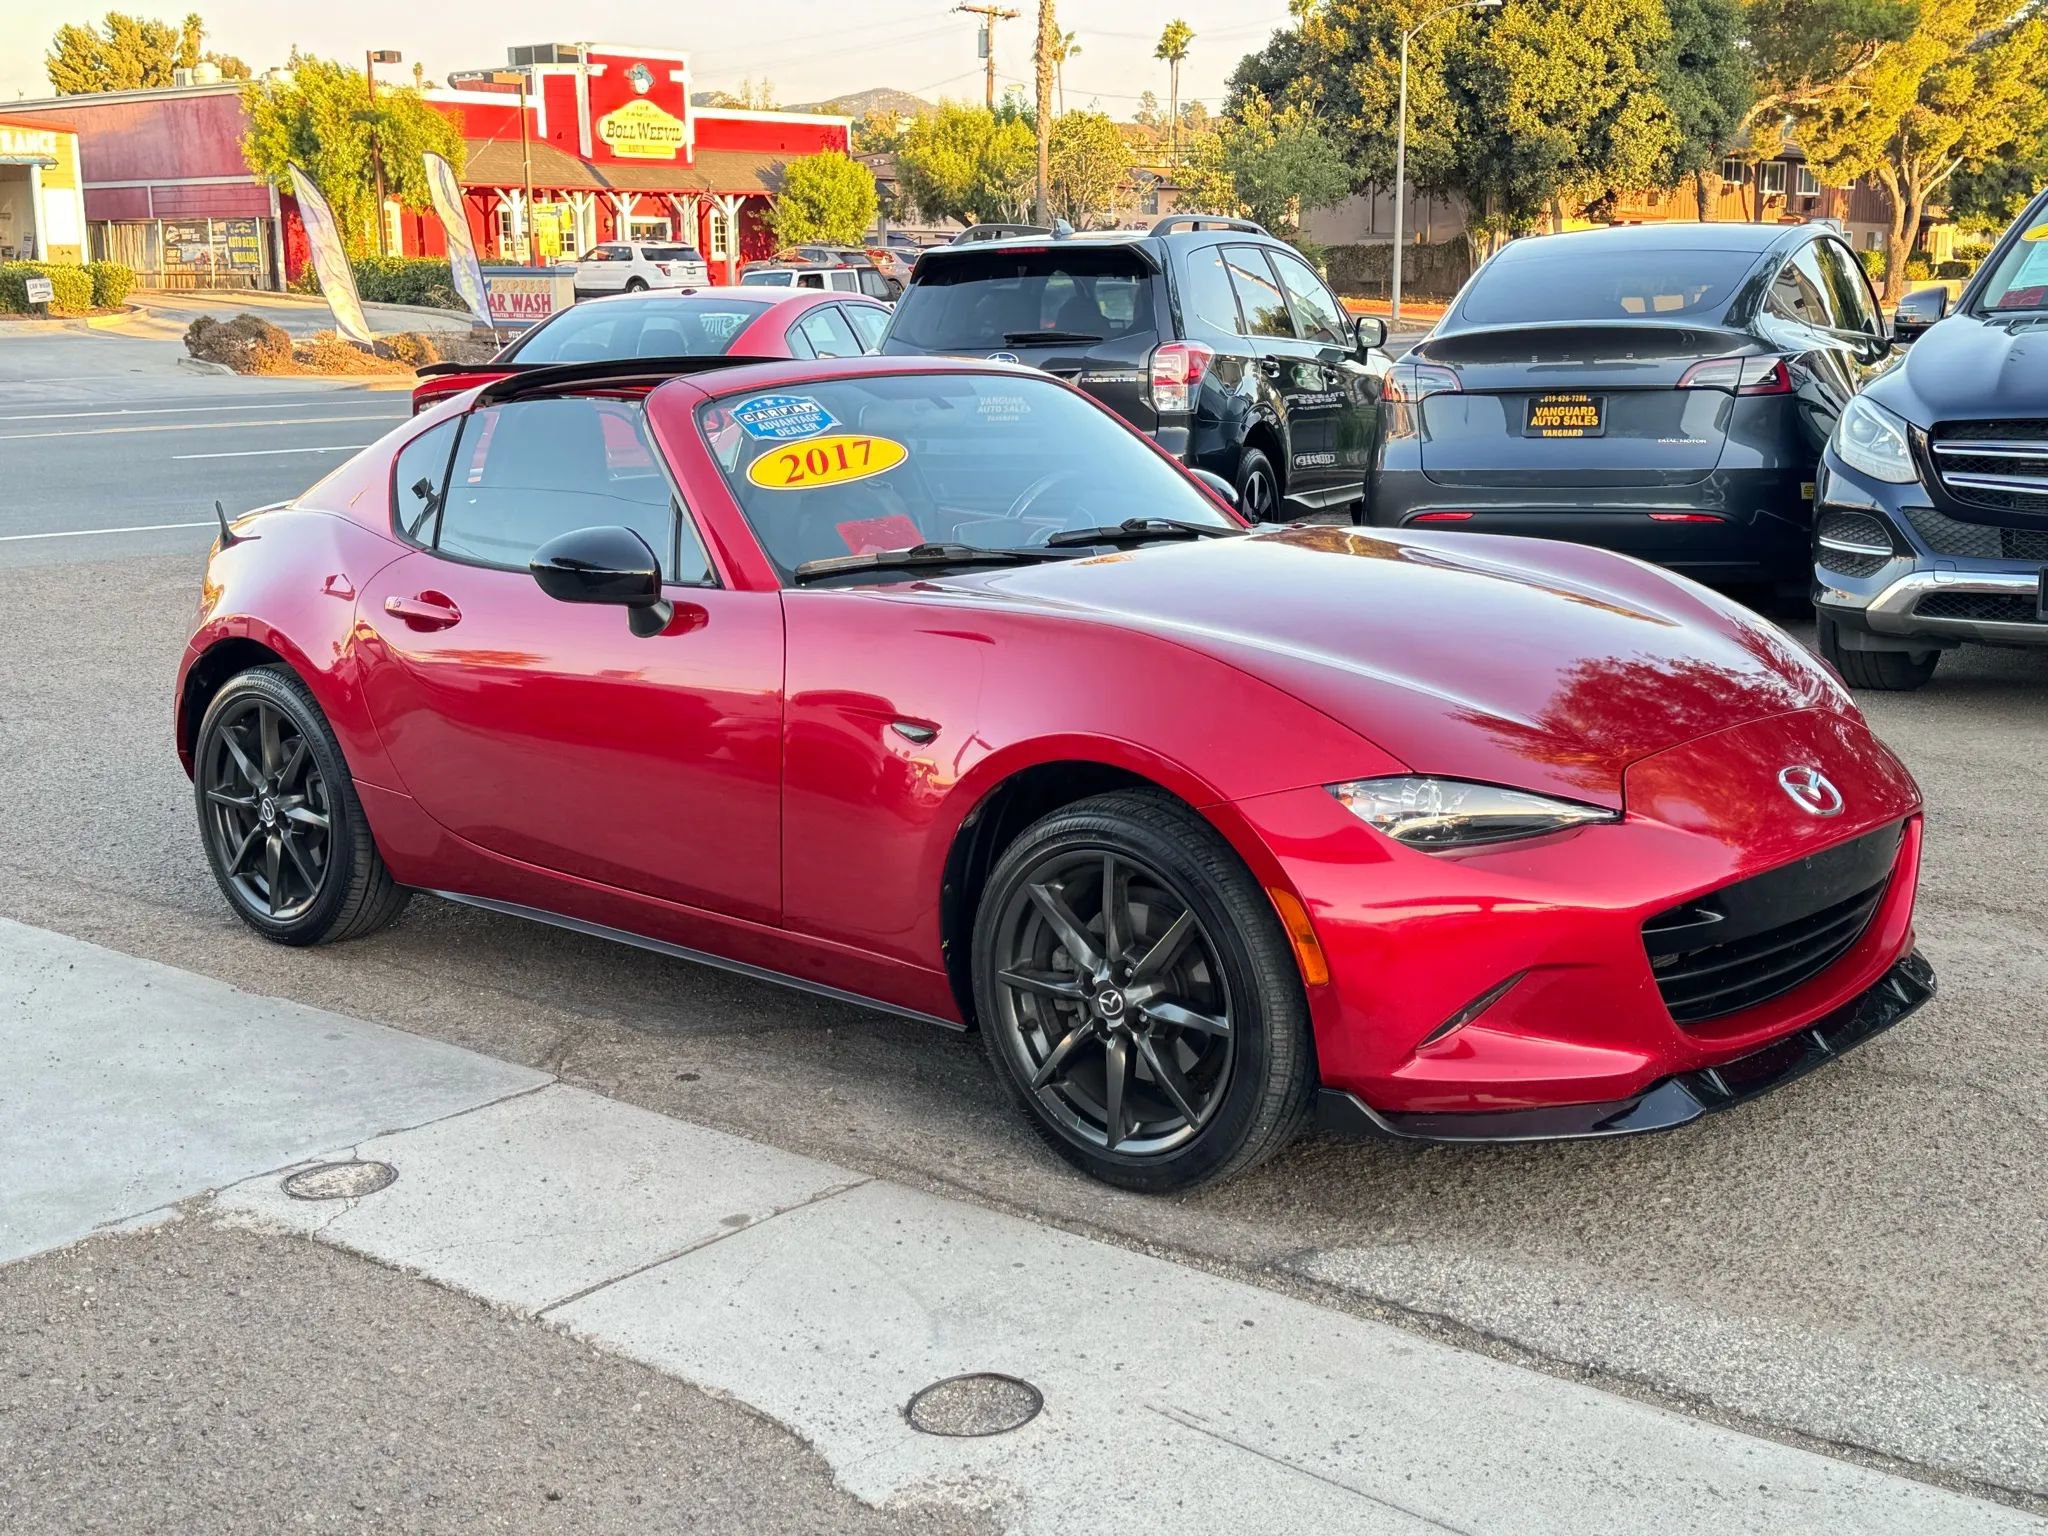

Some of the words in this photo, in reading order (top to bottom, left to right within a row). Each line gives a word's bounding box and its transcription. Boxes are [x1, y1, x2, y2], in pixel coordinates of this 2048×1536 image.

[492, 279, 551, 294] EXPRESS
[489, 293, 507, 312] AR
[510, 293, 552, 312] WASH
[742, 402, 817, 423] CARFAX
[1535, 406, 1596, 417] VANGUARD
[758, 415, 823, 432] ADVANTAGE
[1530, 416, 1561, 426] AUTO
[1563, 415, 1599, 426] SALES
[775, 422, 821, 438] DEALER
[1542, 429, 1584, 437] VANGUARD
[779, 439, 871, 484] 2017
